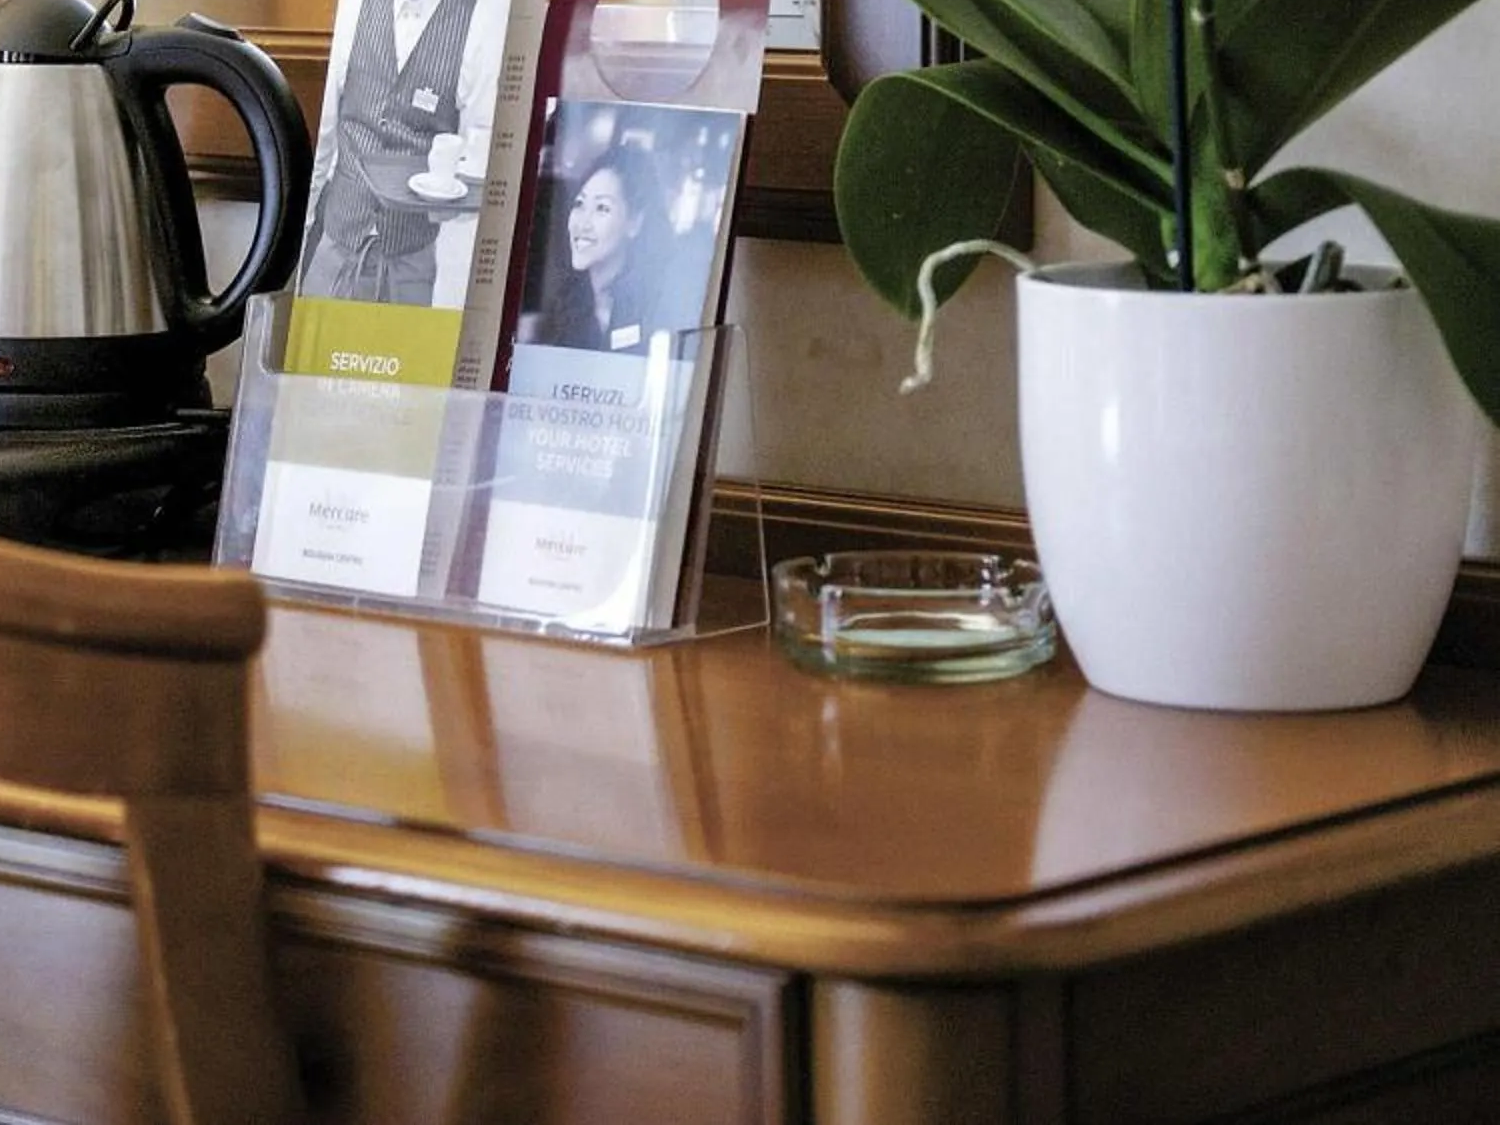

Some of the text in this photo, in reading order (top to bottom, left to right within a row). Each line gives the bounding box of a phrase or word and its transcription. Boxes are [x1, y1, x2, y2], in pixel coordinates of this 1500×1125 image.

[330, 351, 400, 376] SERVIZIO
[560, 384, 625, 406] SERVIZI
[508, 402, 657, 436] DEL VOSTRO HOT
[528, 427, 632, 458] YOUR HOTEL
[535, 451, 614, 479] SERVICES
